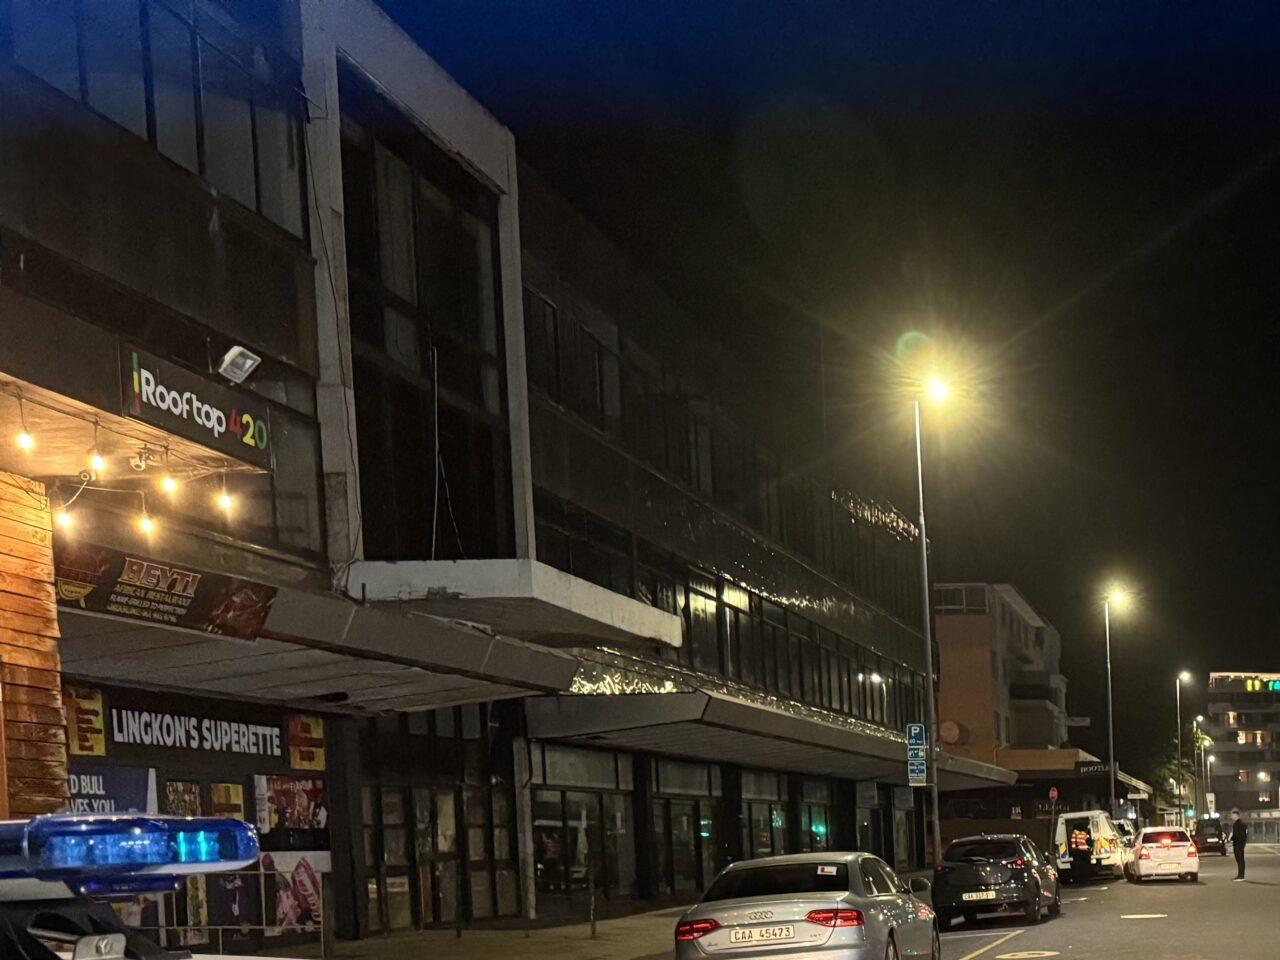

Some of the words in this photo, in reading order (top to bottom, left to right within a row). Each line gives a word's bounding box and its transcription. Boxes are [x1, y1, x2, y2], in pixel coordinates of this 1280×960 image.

[140, 368, 227, 438] Rooftop
[229, 408, 267, 450] 420
[118, 557, 201, 597] BEYTI
[112, 708, 199, 749] LINGKON'S
[201, 717, 281, 757] SUPERETTE
[911, 726, 920, 737] P
[81, 775, 105, 795] BULL
[71, 799, 91, 814] VES
[734, 931, 754, 941] CAA
[759, 927, 791, 938] 45473
